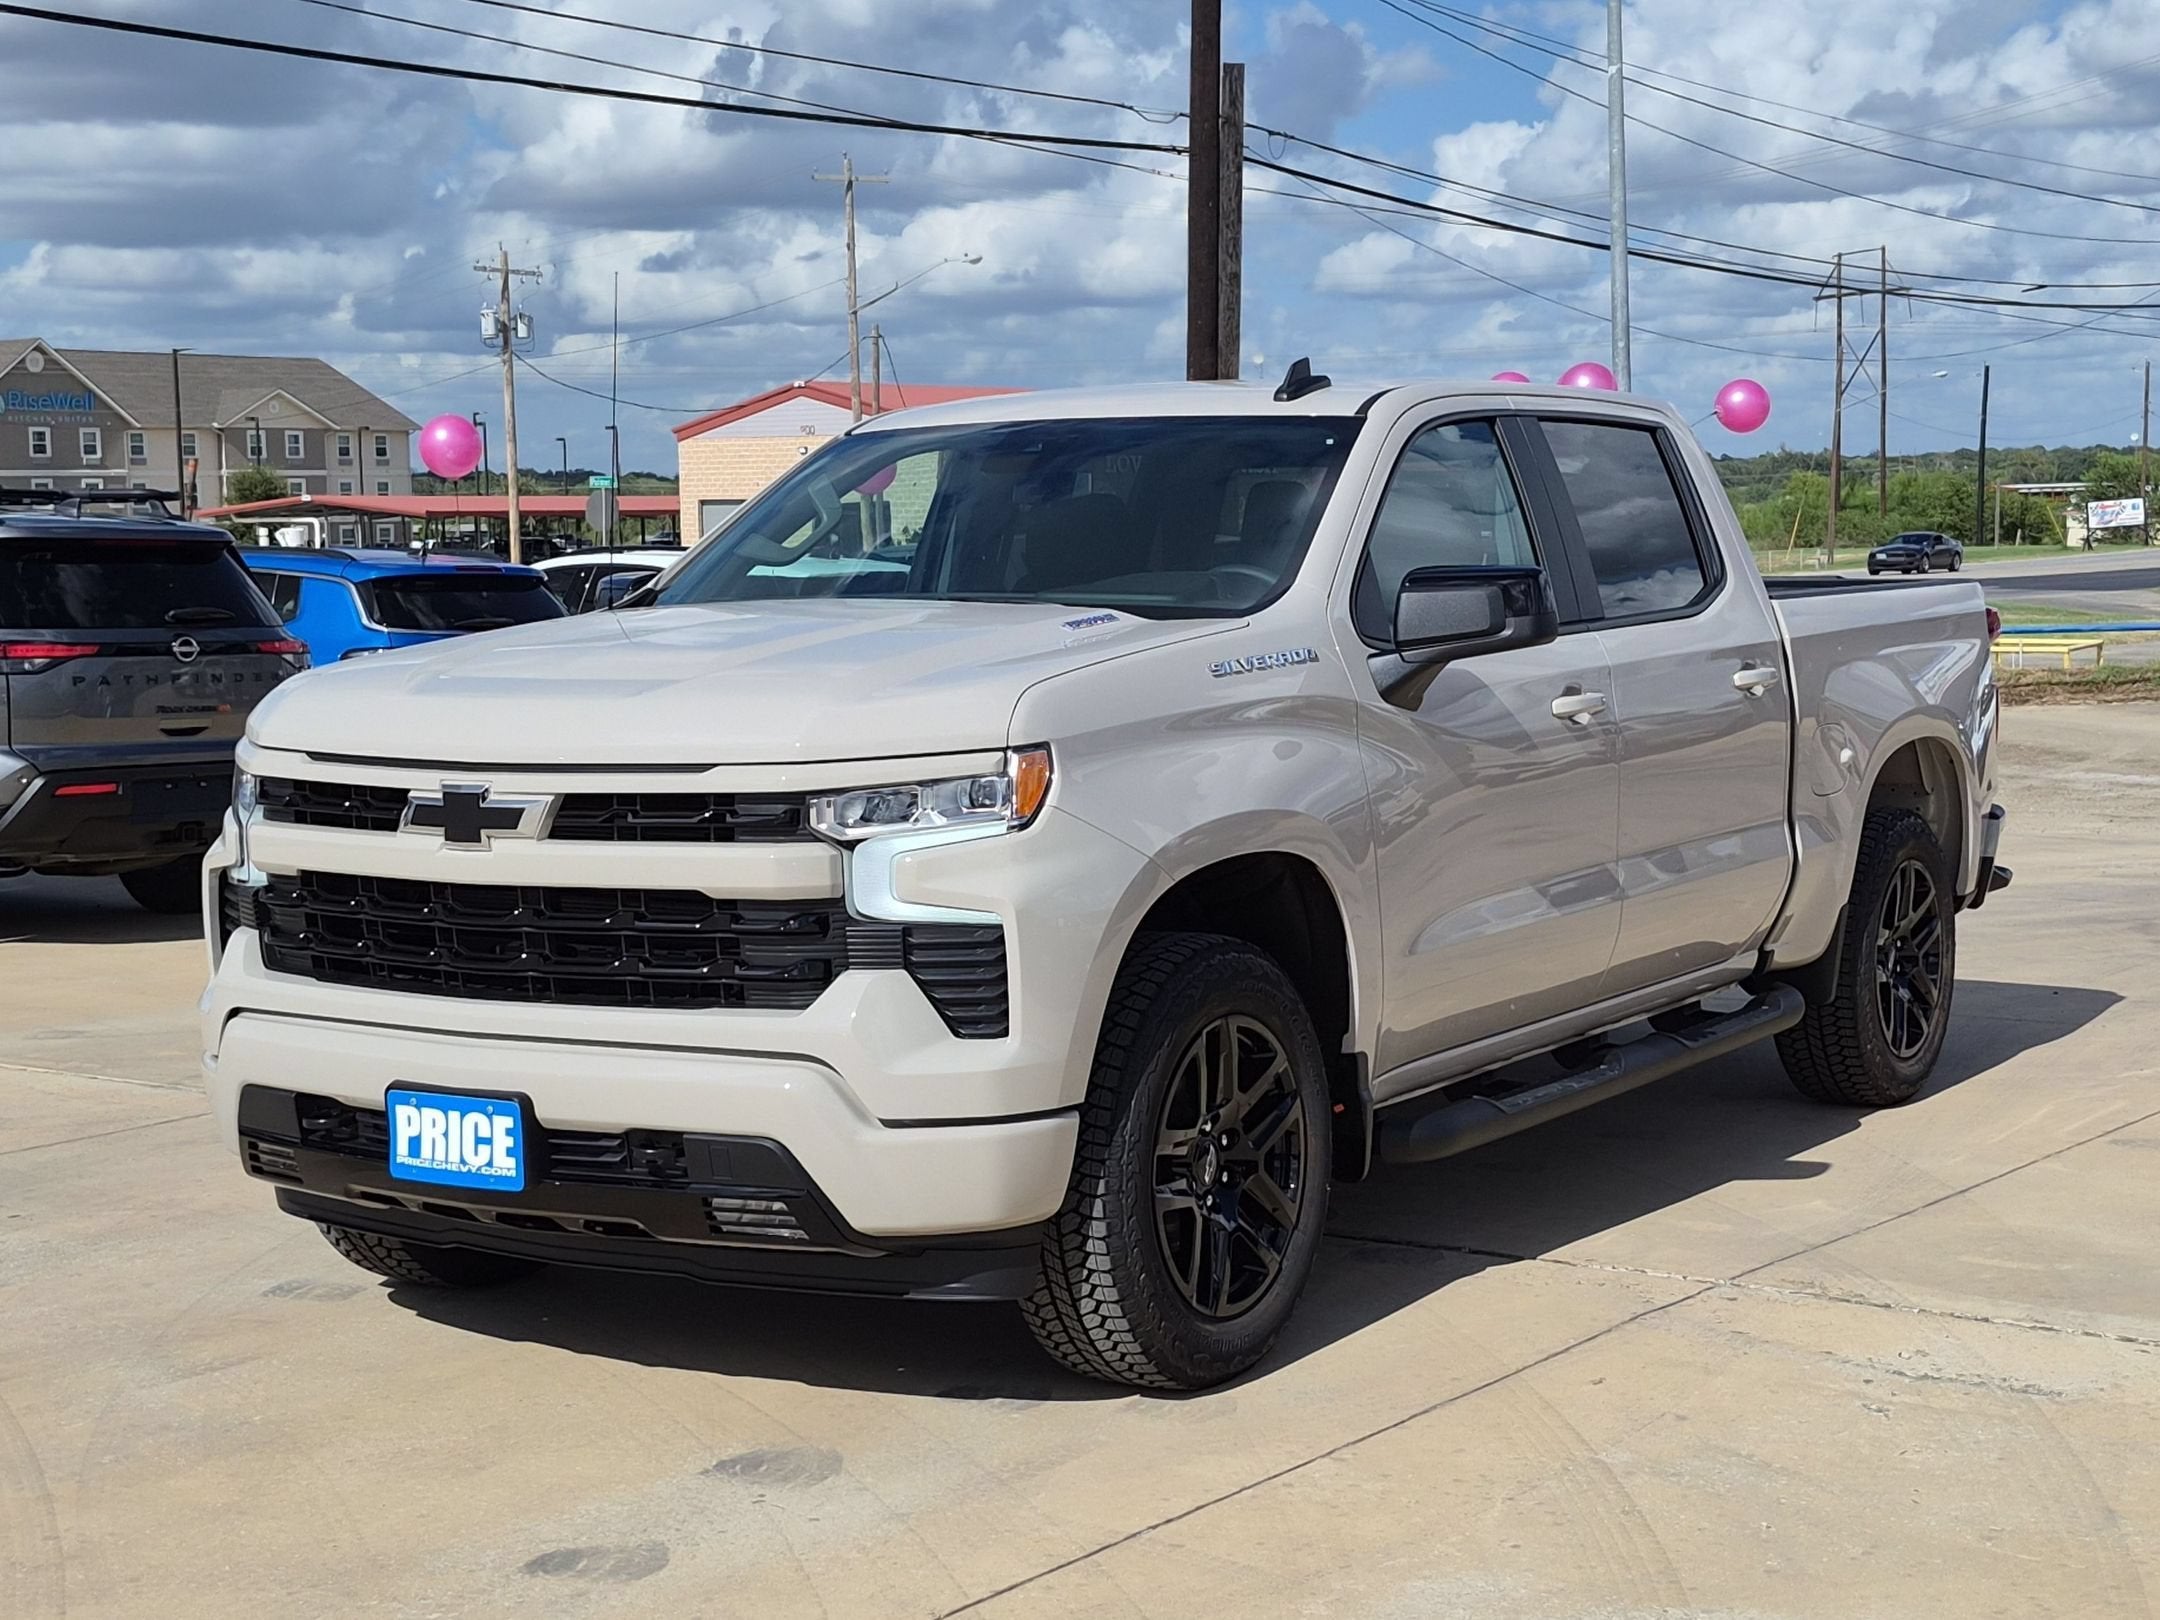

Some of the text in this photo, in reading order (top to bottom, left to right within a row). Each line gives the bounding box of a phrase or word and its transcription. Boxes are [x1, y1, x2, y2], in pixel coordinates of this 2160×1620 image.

[8, 390, 95, 411] RiseWell
[1207, 648, 1320, 678] SILVERADO
[395, 1103, 517, 1169] PRICE
[395, 1155, 517, 1178] PRICECHEVY.COM
